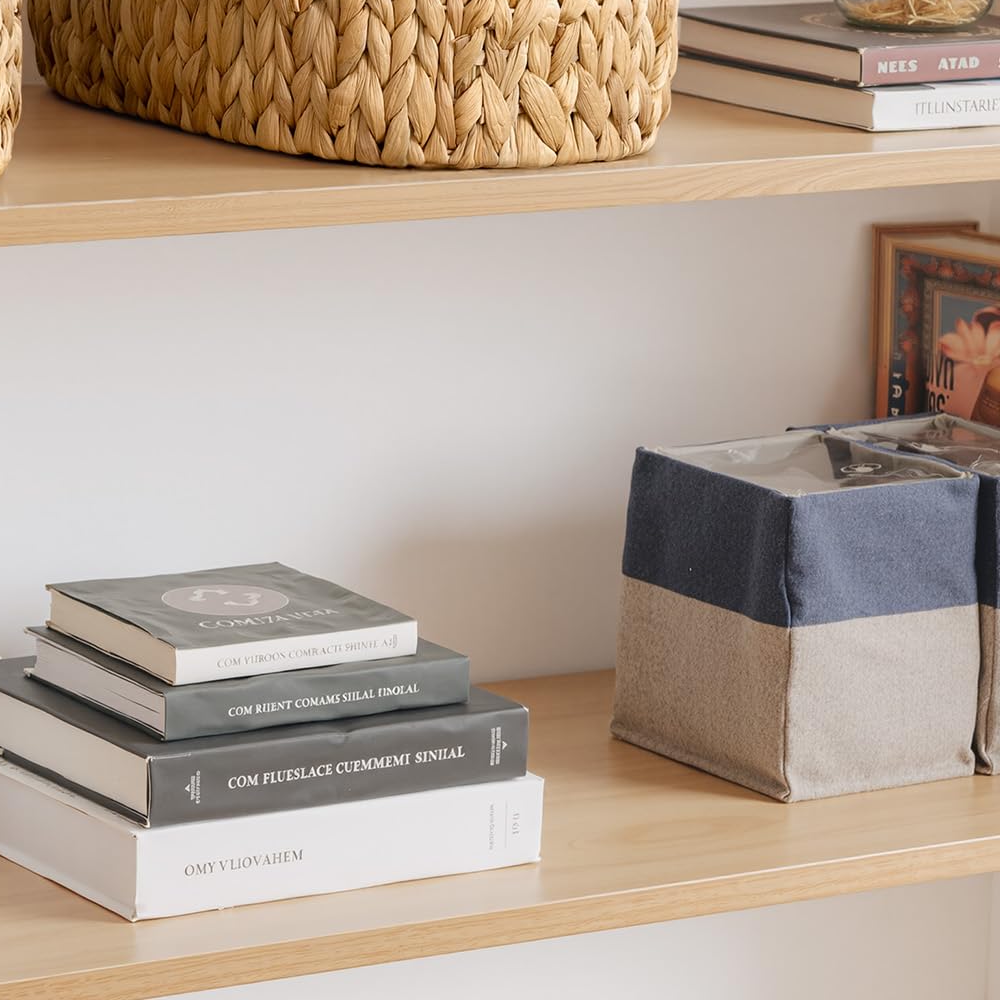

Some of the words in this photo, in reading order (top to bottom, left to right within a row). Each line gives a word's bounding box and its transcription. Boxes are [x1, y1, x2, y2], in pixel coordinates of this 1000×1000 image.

[877, 59, 918, 74] NEES
[228, 705, 253, 717] COM
[228, 773, 259, 789] COM
[263, 763, 333, 785] FLUESLACE
